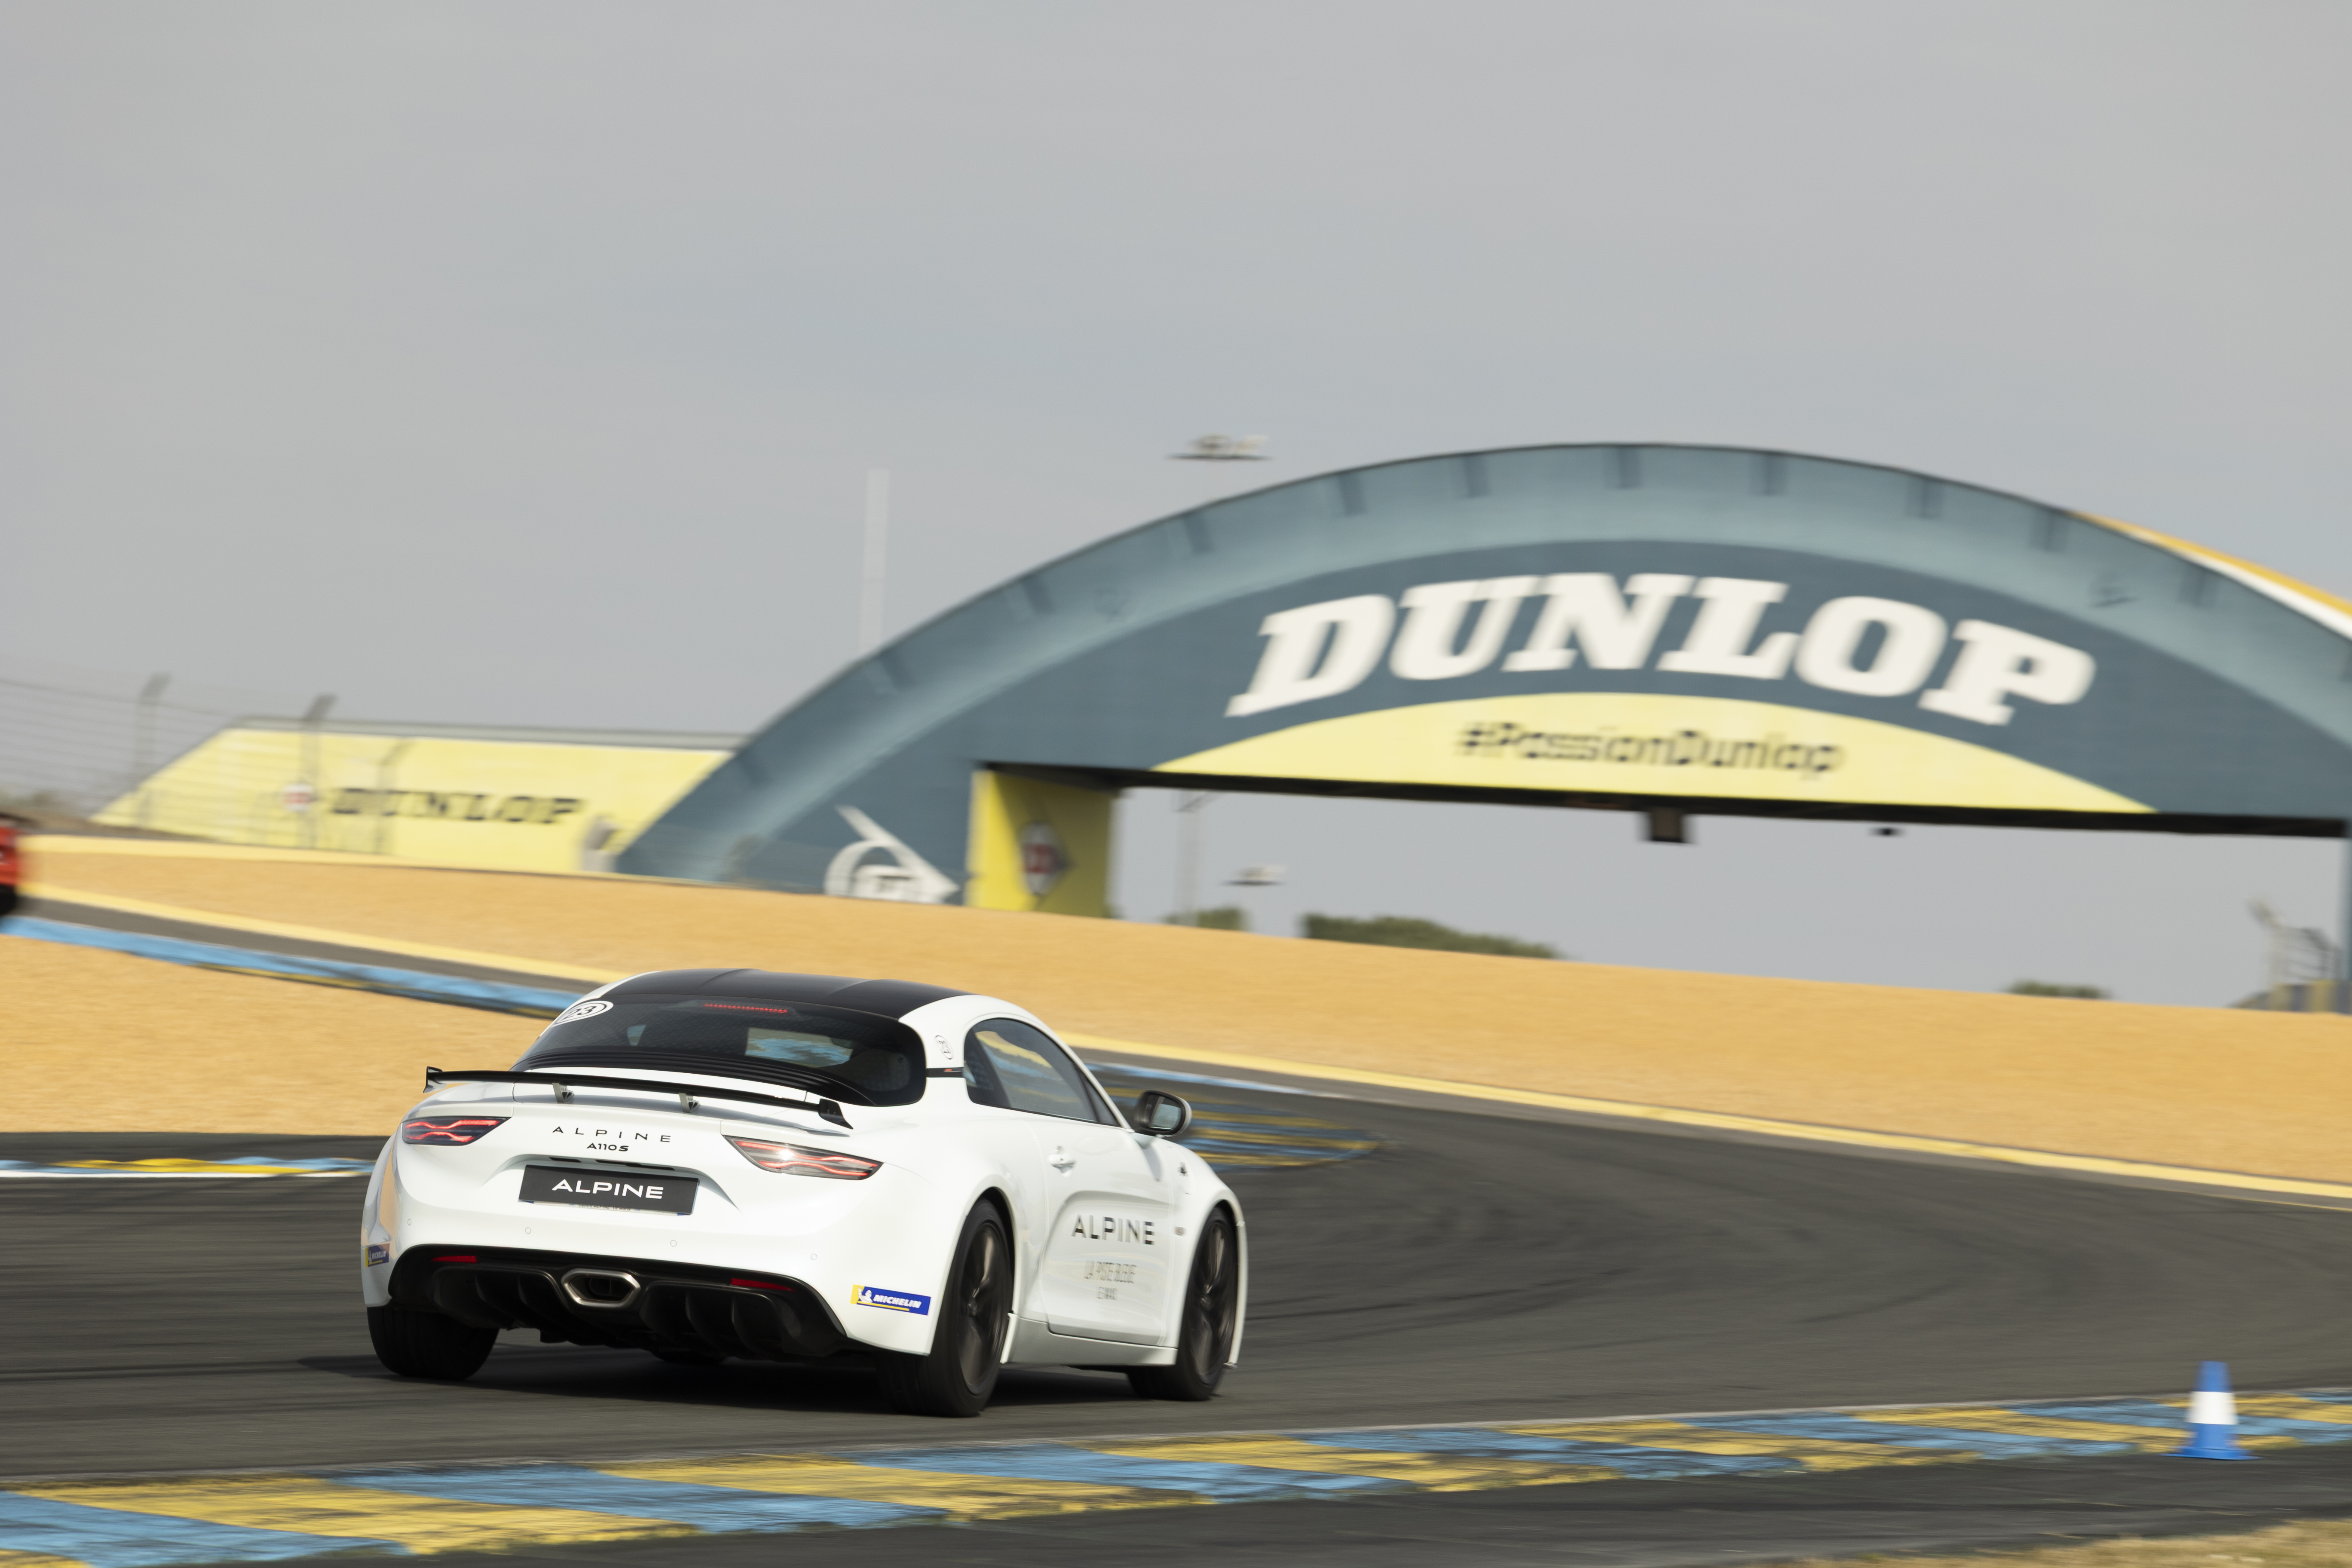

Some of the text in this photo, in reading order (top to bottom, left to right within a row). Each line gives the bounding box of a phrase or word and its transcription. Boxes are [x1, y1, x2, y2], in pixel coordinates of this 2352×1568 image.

[1224, 573, 2097, 726] DUNLOP
[1456, 722, 1844, 780] #PassionDunlop
[330, 787, 584, 825] DUNLOP
[561, 1005, 597, 1020] 23
[552, 1126, 671, 1142] ALPINE
[586, 1143, 629, 1152] A110S
[551, 1179, 664, 1199] ALPINE
[1071, 1214, 1155, 1245] ALPINE
[873, 1294, 922, 1308] MICHELIN
